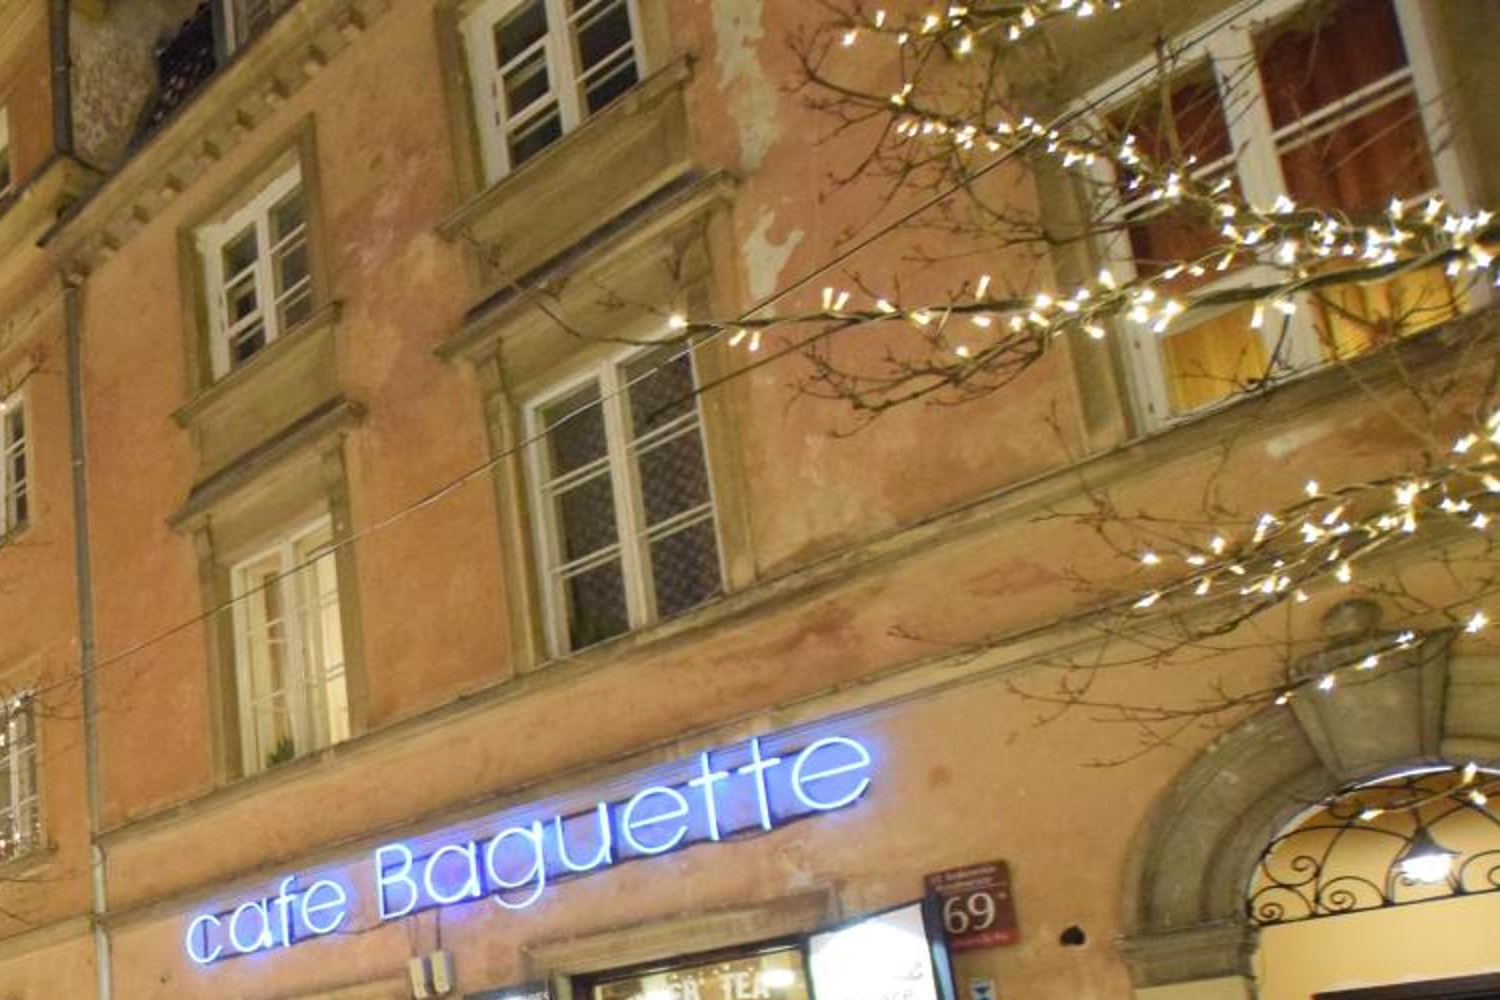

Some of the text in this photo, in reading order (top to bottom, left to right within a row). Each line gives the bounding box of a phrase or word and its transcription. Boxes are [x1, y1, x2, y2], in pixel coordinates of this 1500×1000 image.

[186, 736, 871, 963] cafe Baguette
[943, 892, 996, 935] 69
